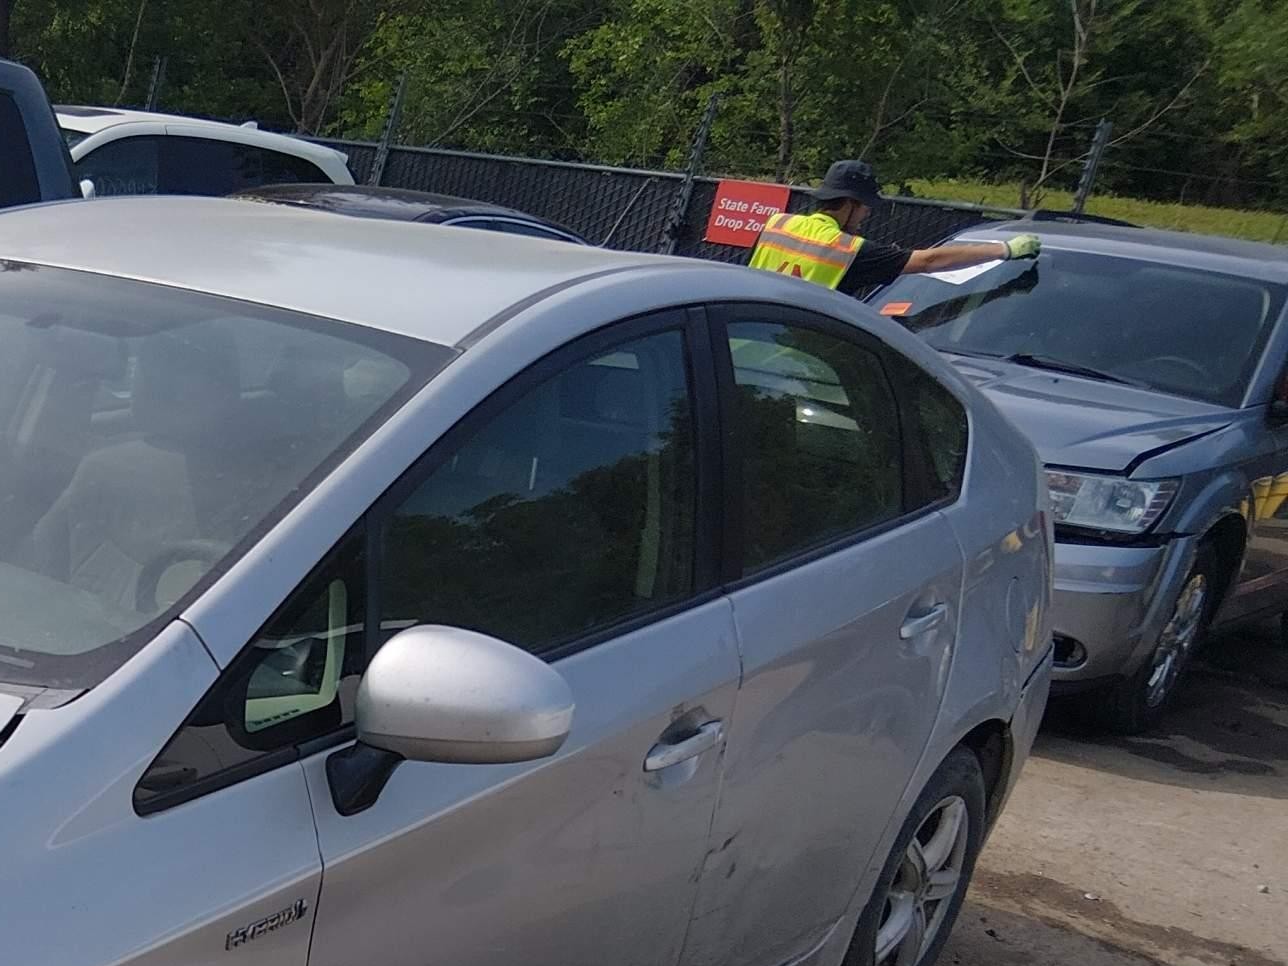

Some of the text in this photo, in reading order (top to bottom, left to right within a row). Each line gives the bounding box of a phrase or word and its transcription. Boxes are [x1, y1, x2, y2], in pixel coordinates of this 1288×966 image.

[718, 198, 779, 216] State Farm
[714, 215, 743, 231] Drop
